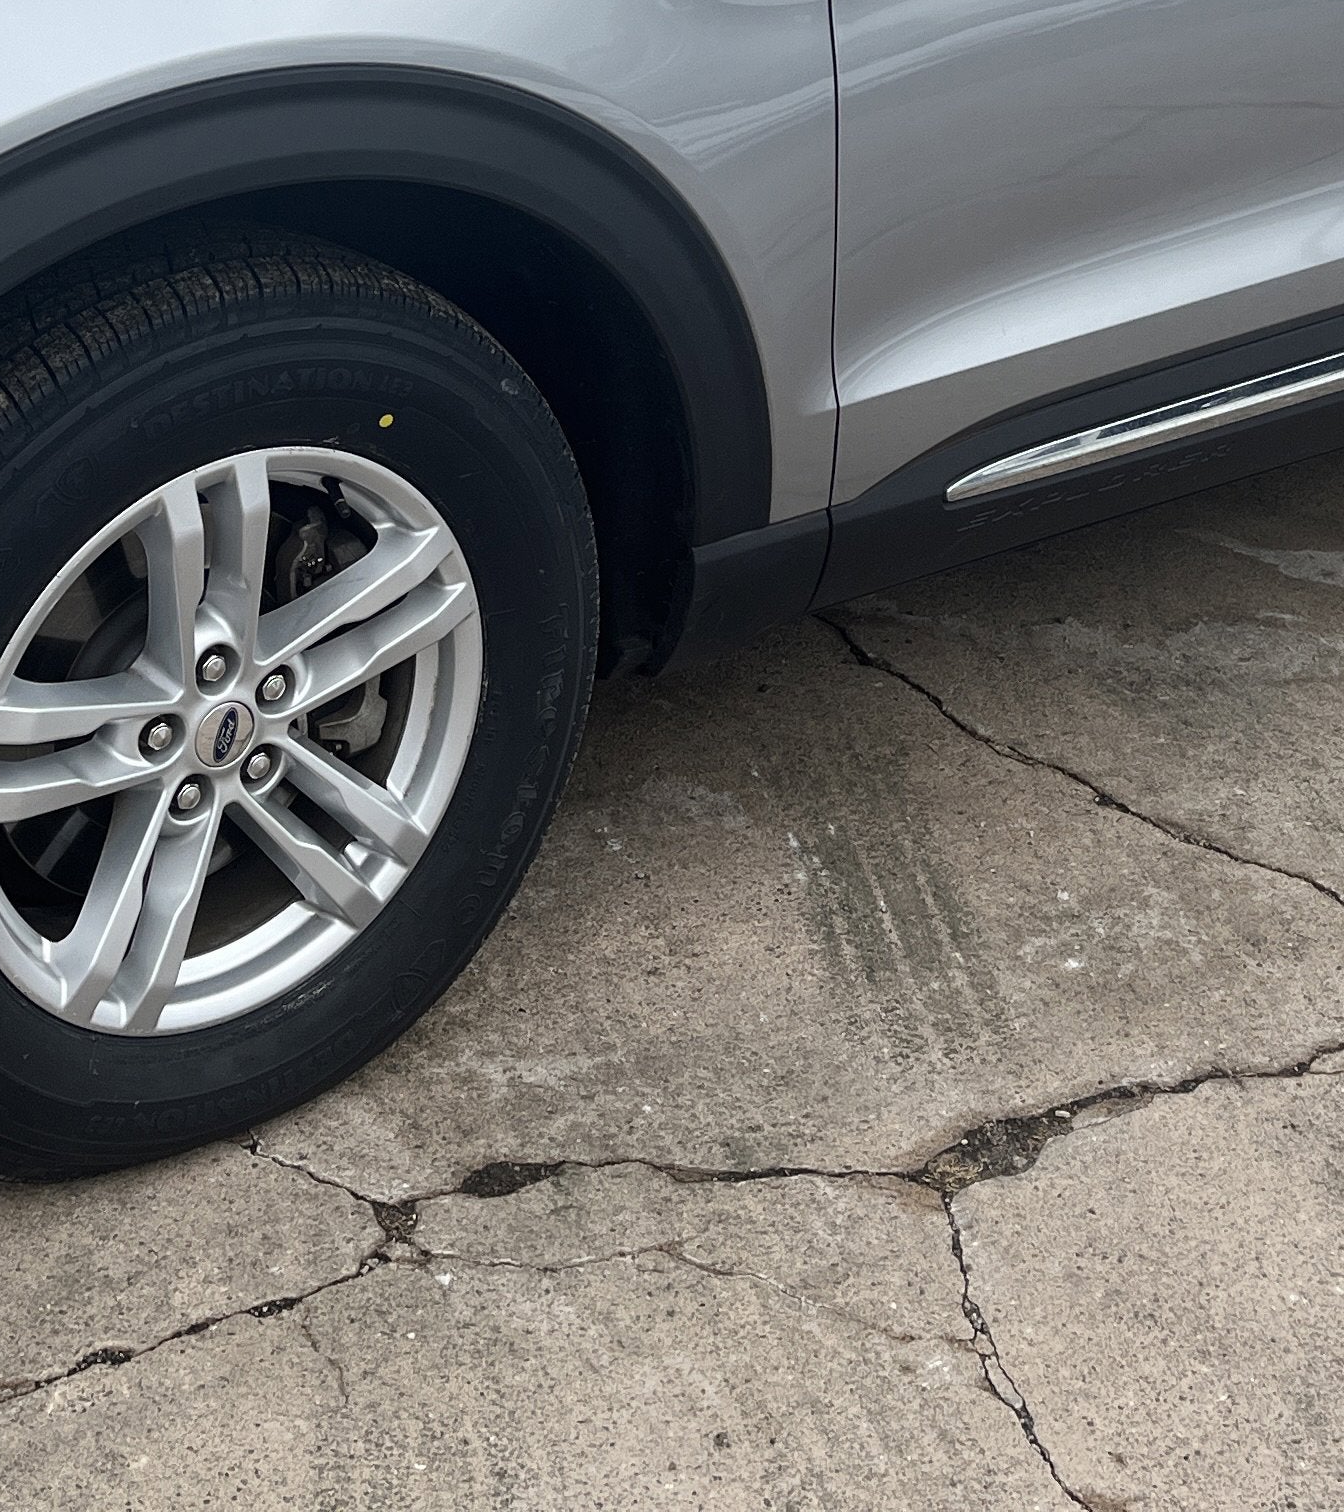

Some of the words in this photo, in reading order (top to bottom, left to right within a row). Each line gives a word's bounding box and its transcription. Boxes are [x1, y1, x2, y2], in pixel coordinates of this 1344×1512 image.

[140, 366, 372, 439] DESTINATION
[956, 442, 1233, 534] EXPLORER
[218, 718, 235, 753] Ford
